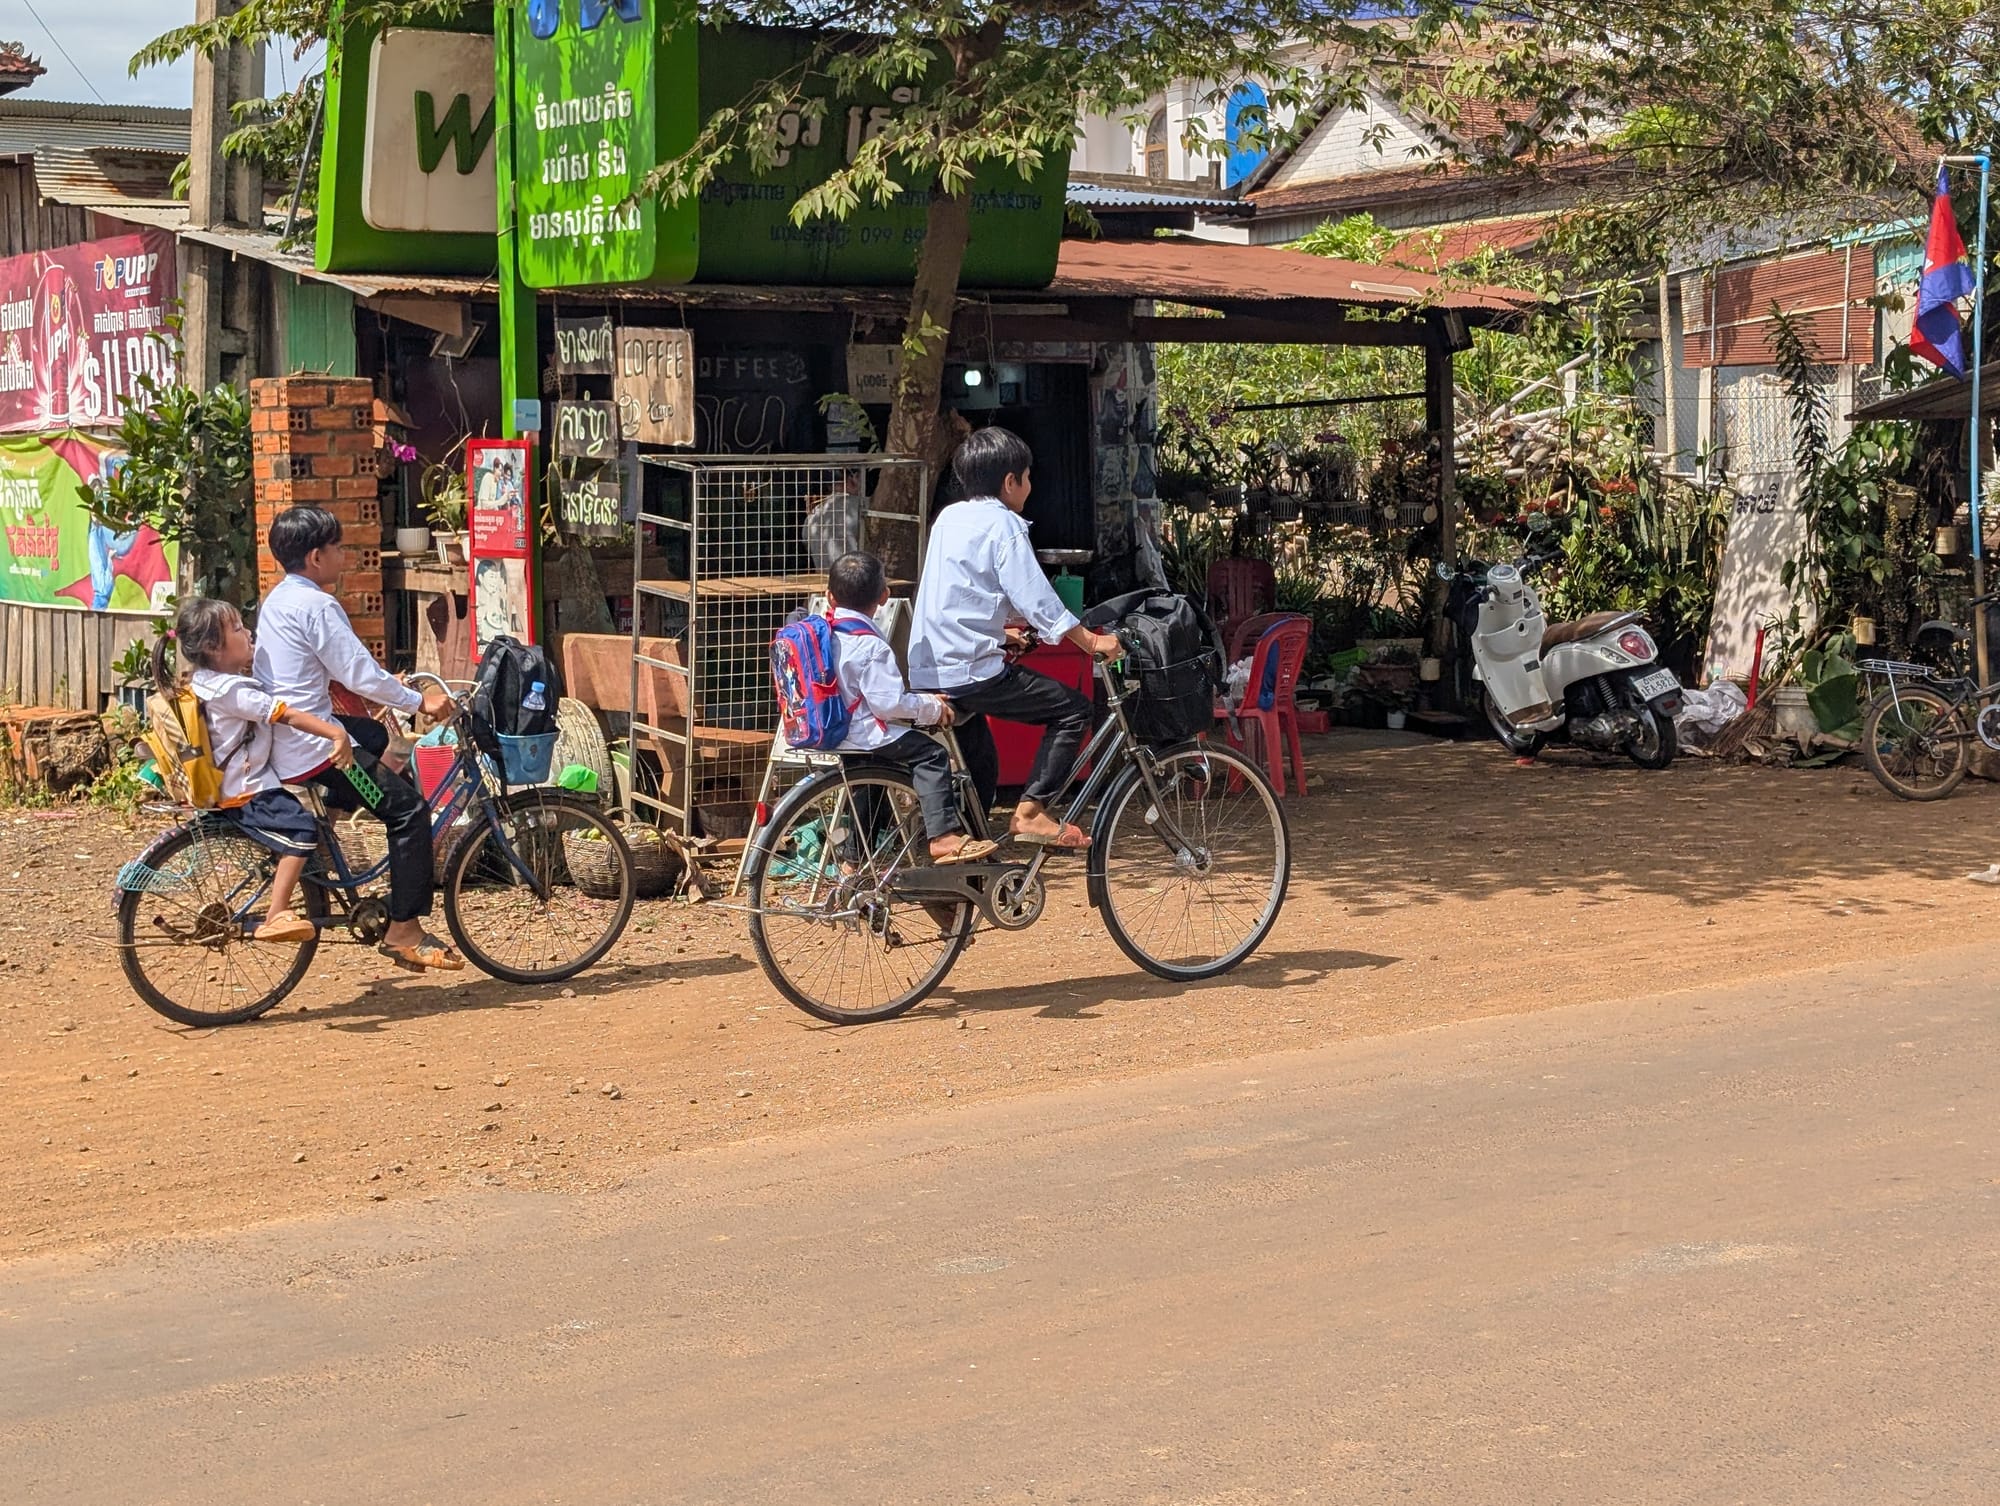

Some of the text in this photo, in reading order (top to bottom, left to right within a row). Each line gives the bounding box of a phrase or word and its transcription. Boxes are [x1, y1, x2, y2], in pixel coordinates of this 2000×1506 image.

[597, 138, 627, 178] និង
[623, 339, 684, 379] COFFEE
[699, 357, 779, 379] OFFEE
